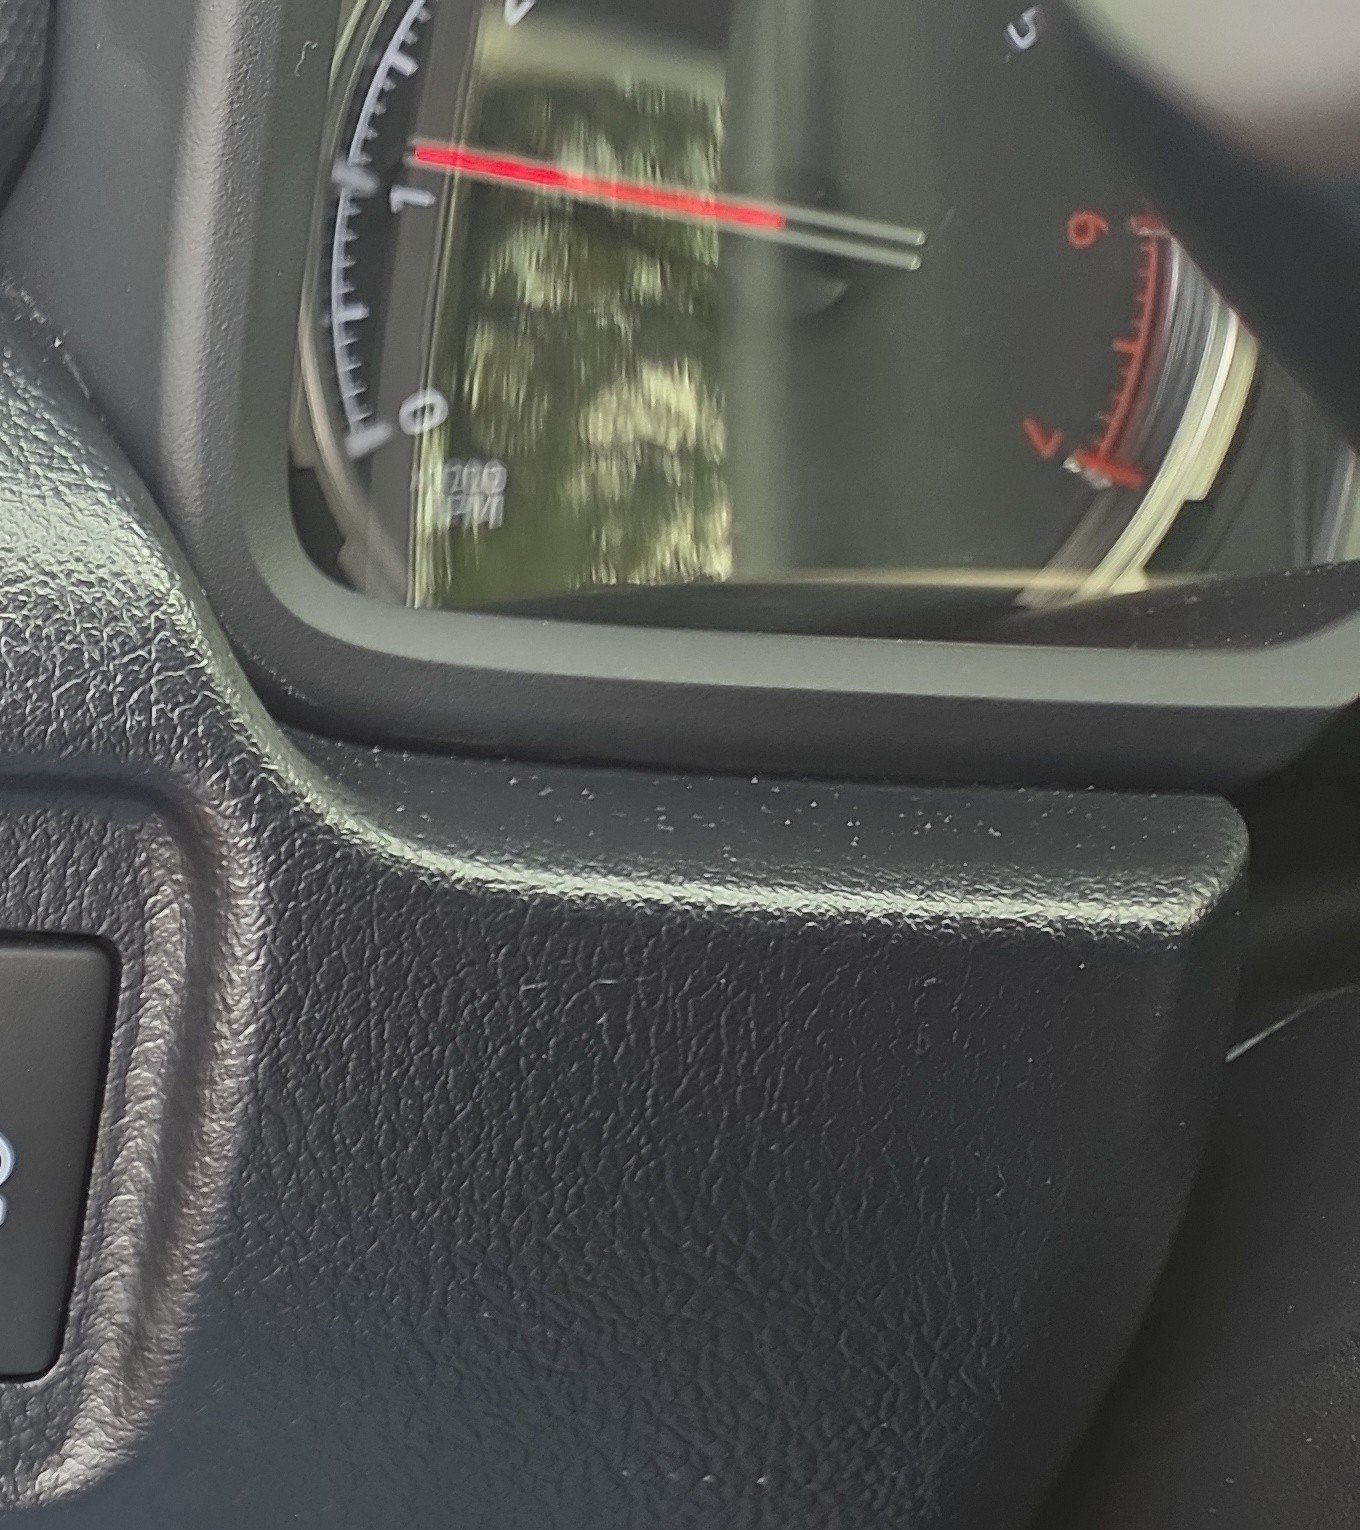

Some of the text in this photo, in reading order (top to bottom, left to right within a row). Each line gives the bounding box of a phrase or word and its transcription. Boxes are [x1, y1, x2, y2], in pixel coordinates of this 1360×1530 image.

[390, 185, 435, 213] 1
[1068, 211, 1108, 249] 6
[399, 388, 448, 435] 0
[1023, 419, 1064, 458] 7
